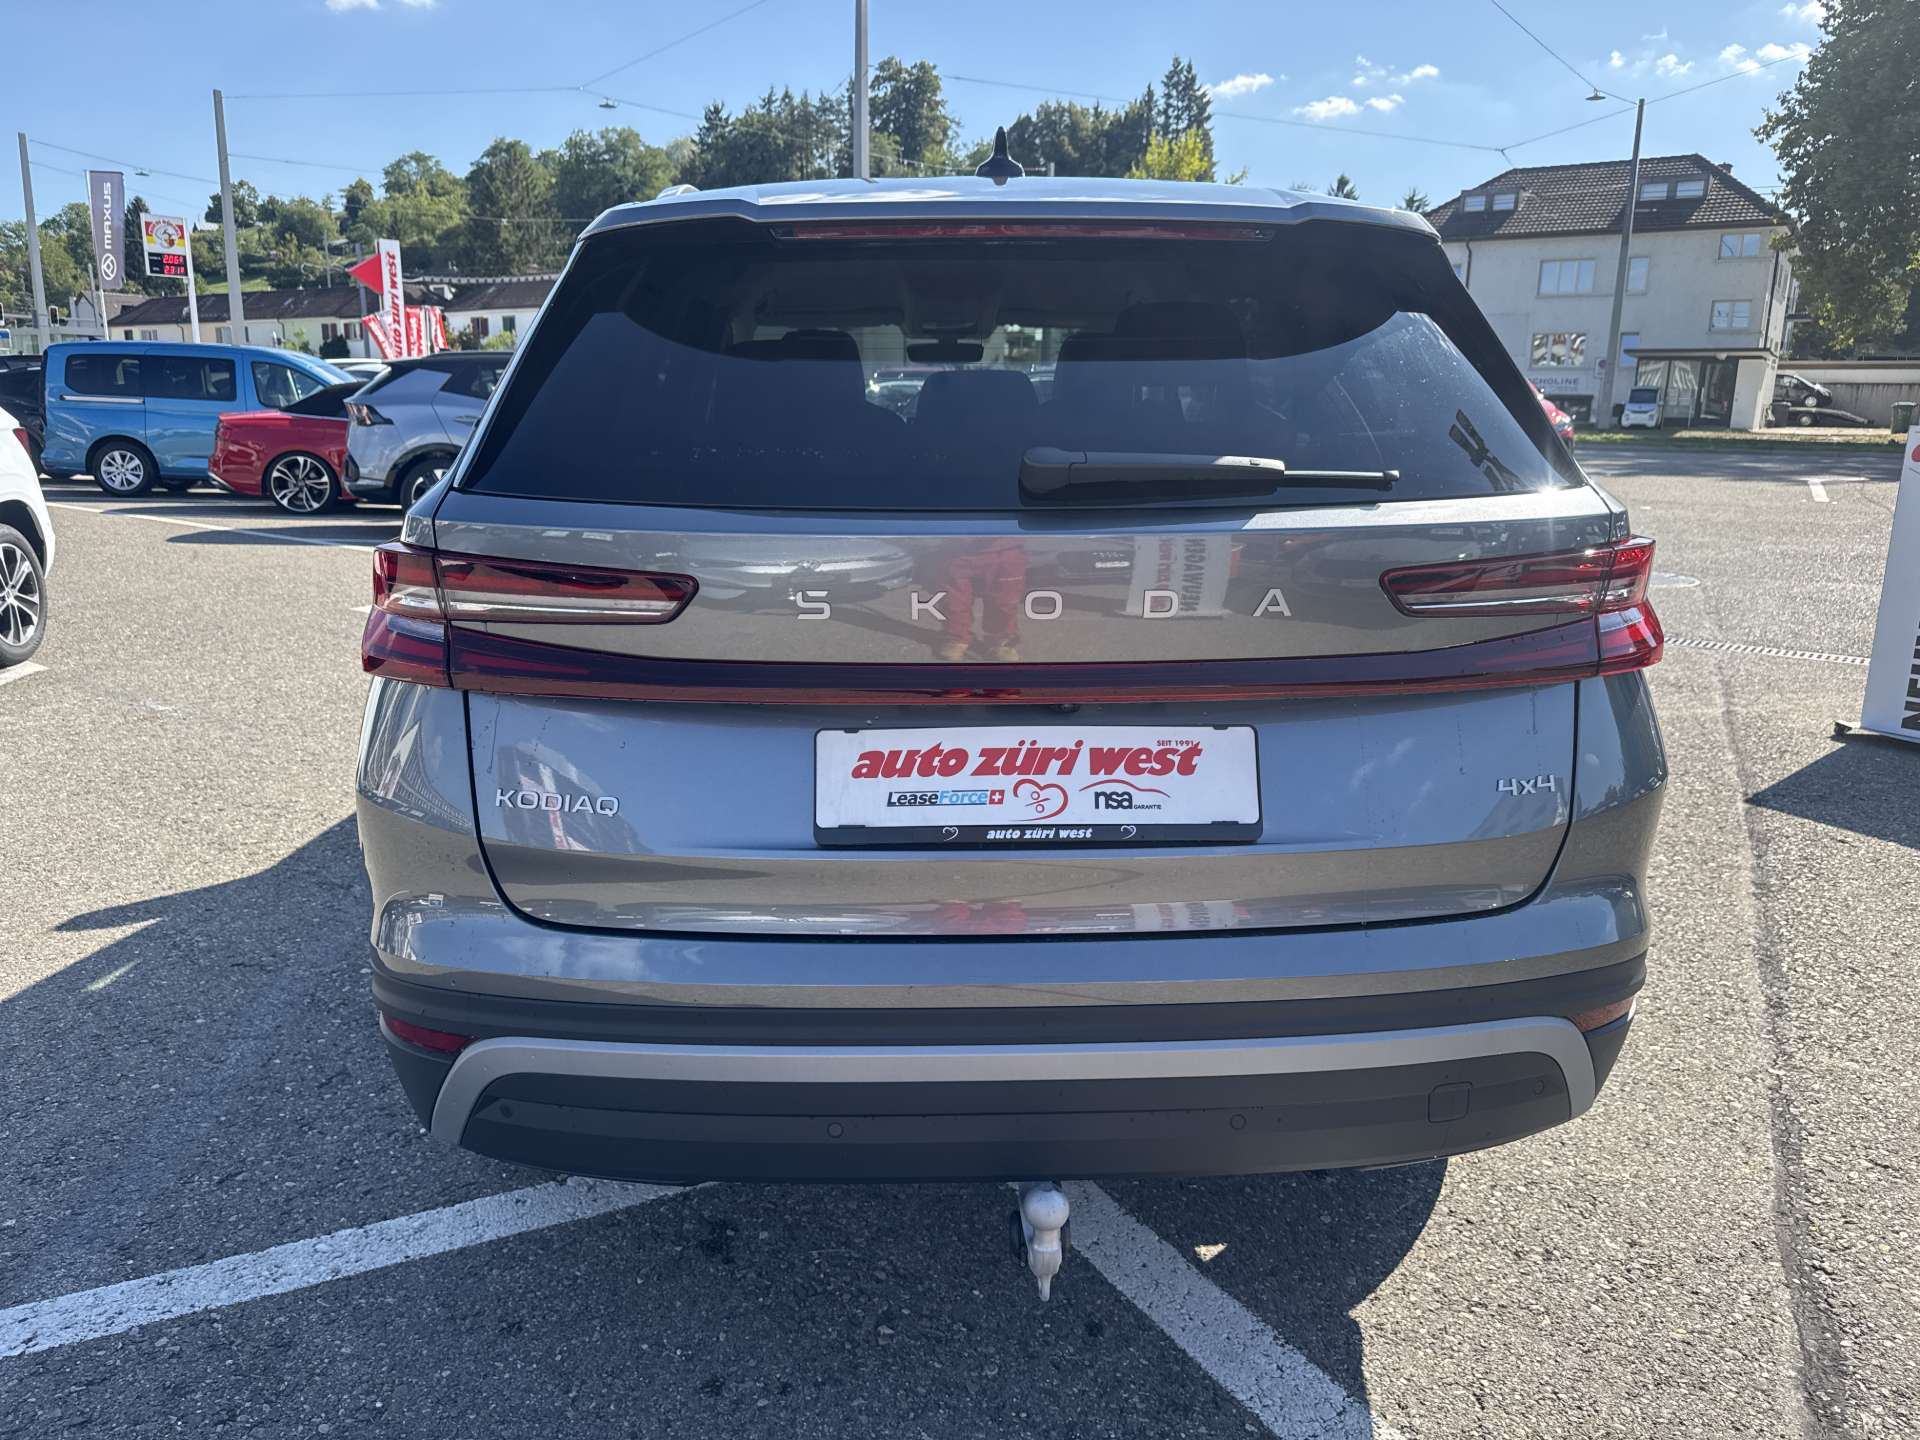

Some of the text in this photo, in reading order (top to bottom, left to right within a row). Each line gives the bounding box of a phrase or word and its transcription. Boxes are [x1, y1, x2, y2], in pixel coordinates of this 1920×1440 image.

[103, 181, 112, 250] MAXUS
[386, 252, 398, 290] west
[1156, 739, 1194, 747] SEIT 1991
[851, 739, 1203, 779] auto züri west
[1497, 774, 1556, 797] 4x4
[495, 788, 620, 817] KODIAQ
[886, 789, 989, 807] LeaseForce
[1094, 791, 1133, 810] nsa
[986, 827, 1093, 839] auto züri west
